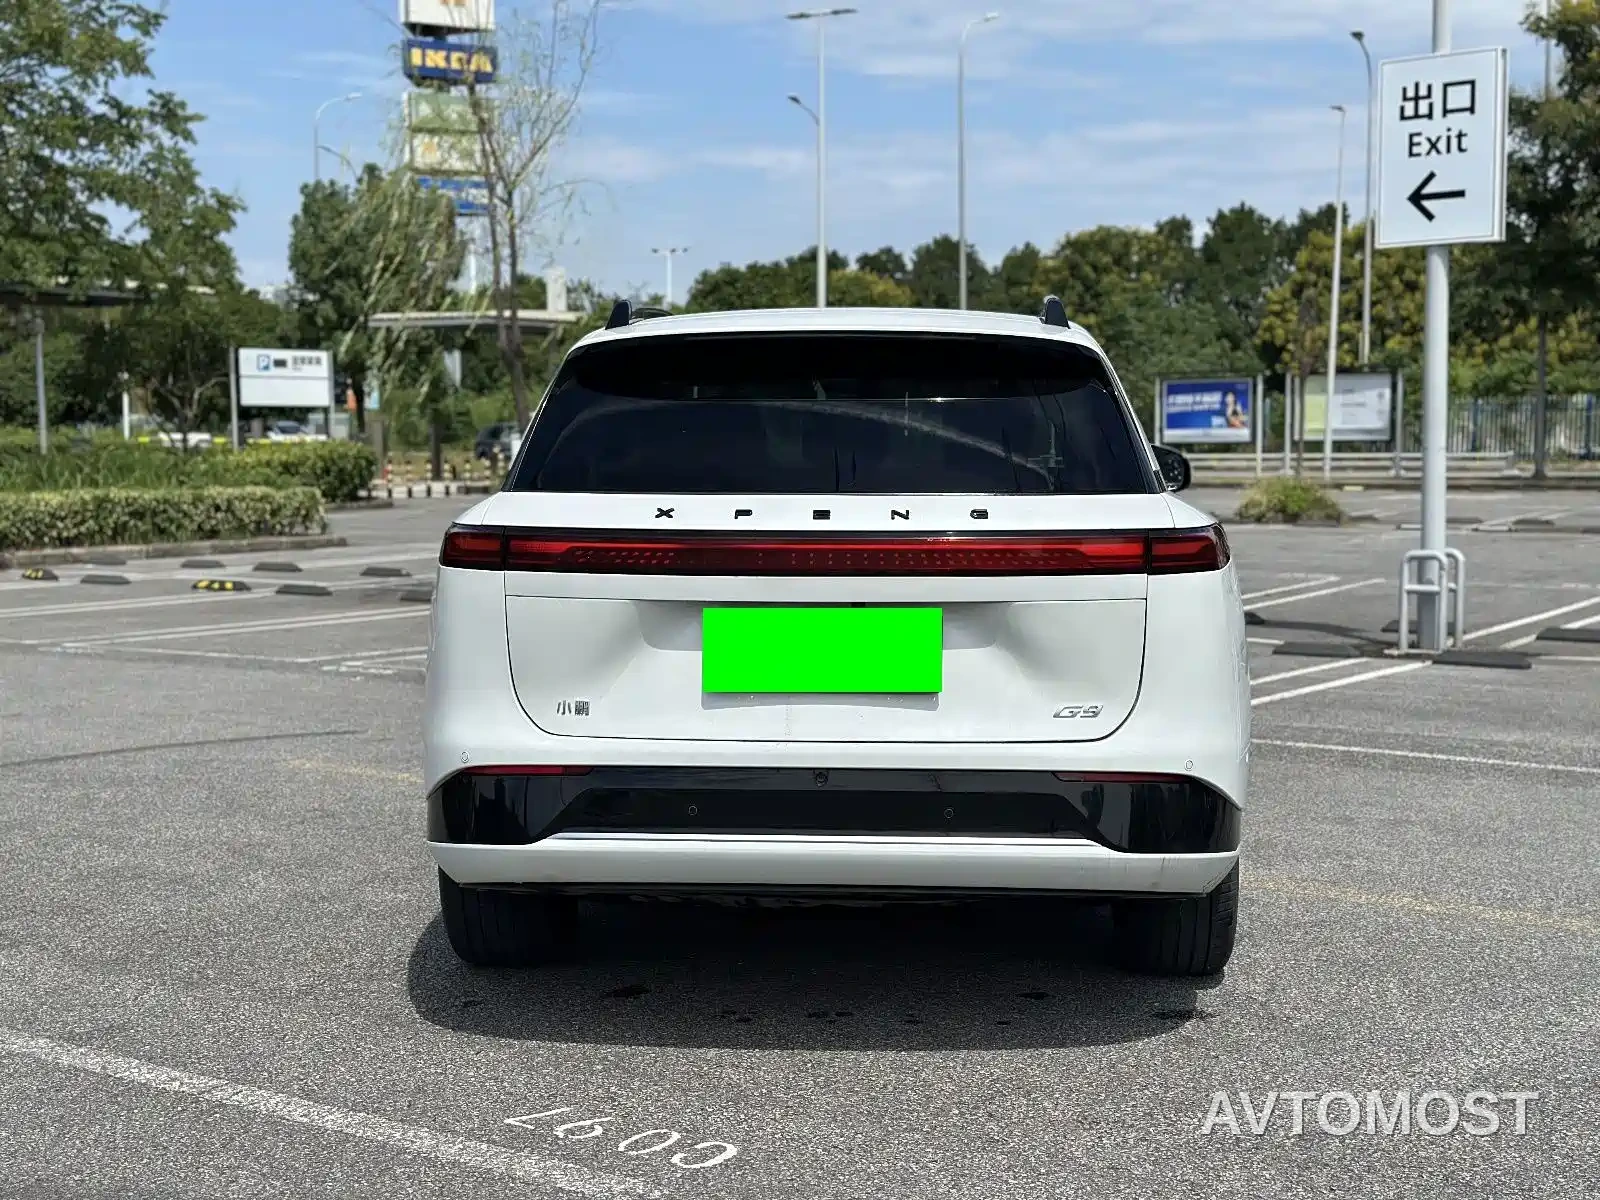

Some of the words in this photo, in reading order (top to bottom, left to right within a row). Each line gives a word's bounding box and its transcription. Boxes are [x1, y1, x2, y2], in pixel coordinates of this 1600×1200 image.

[1399, 79, 1476, 121] 出口
[1407, 127, 1468, 159] Exit
[655, 507, 989, 520] XPENG
[1053, 705, 1103, 718] G9
